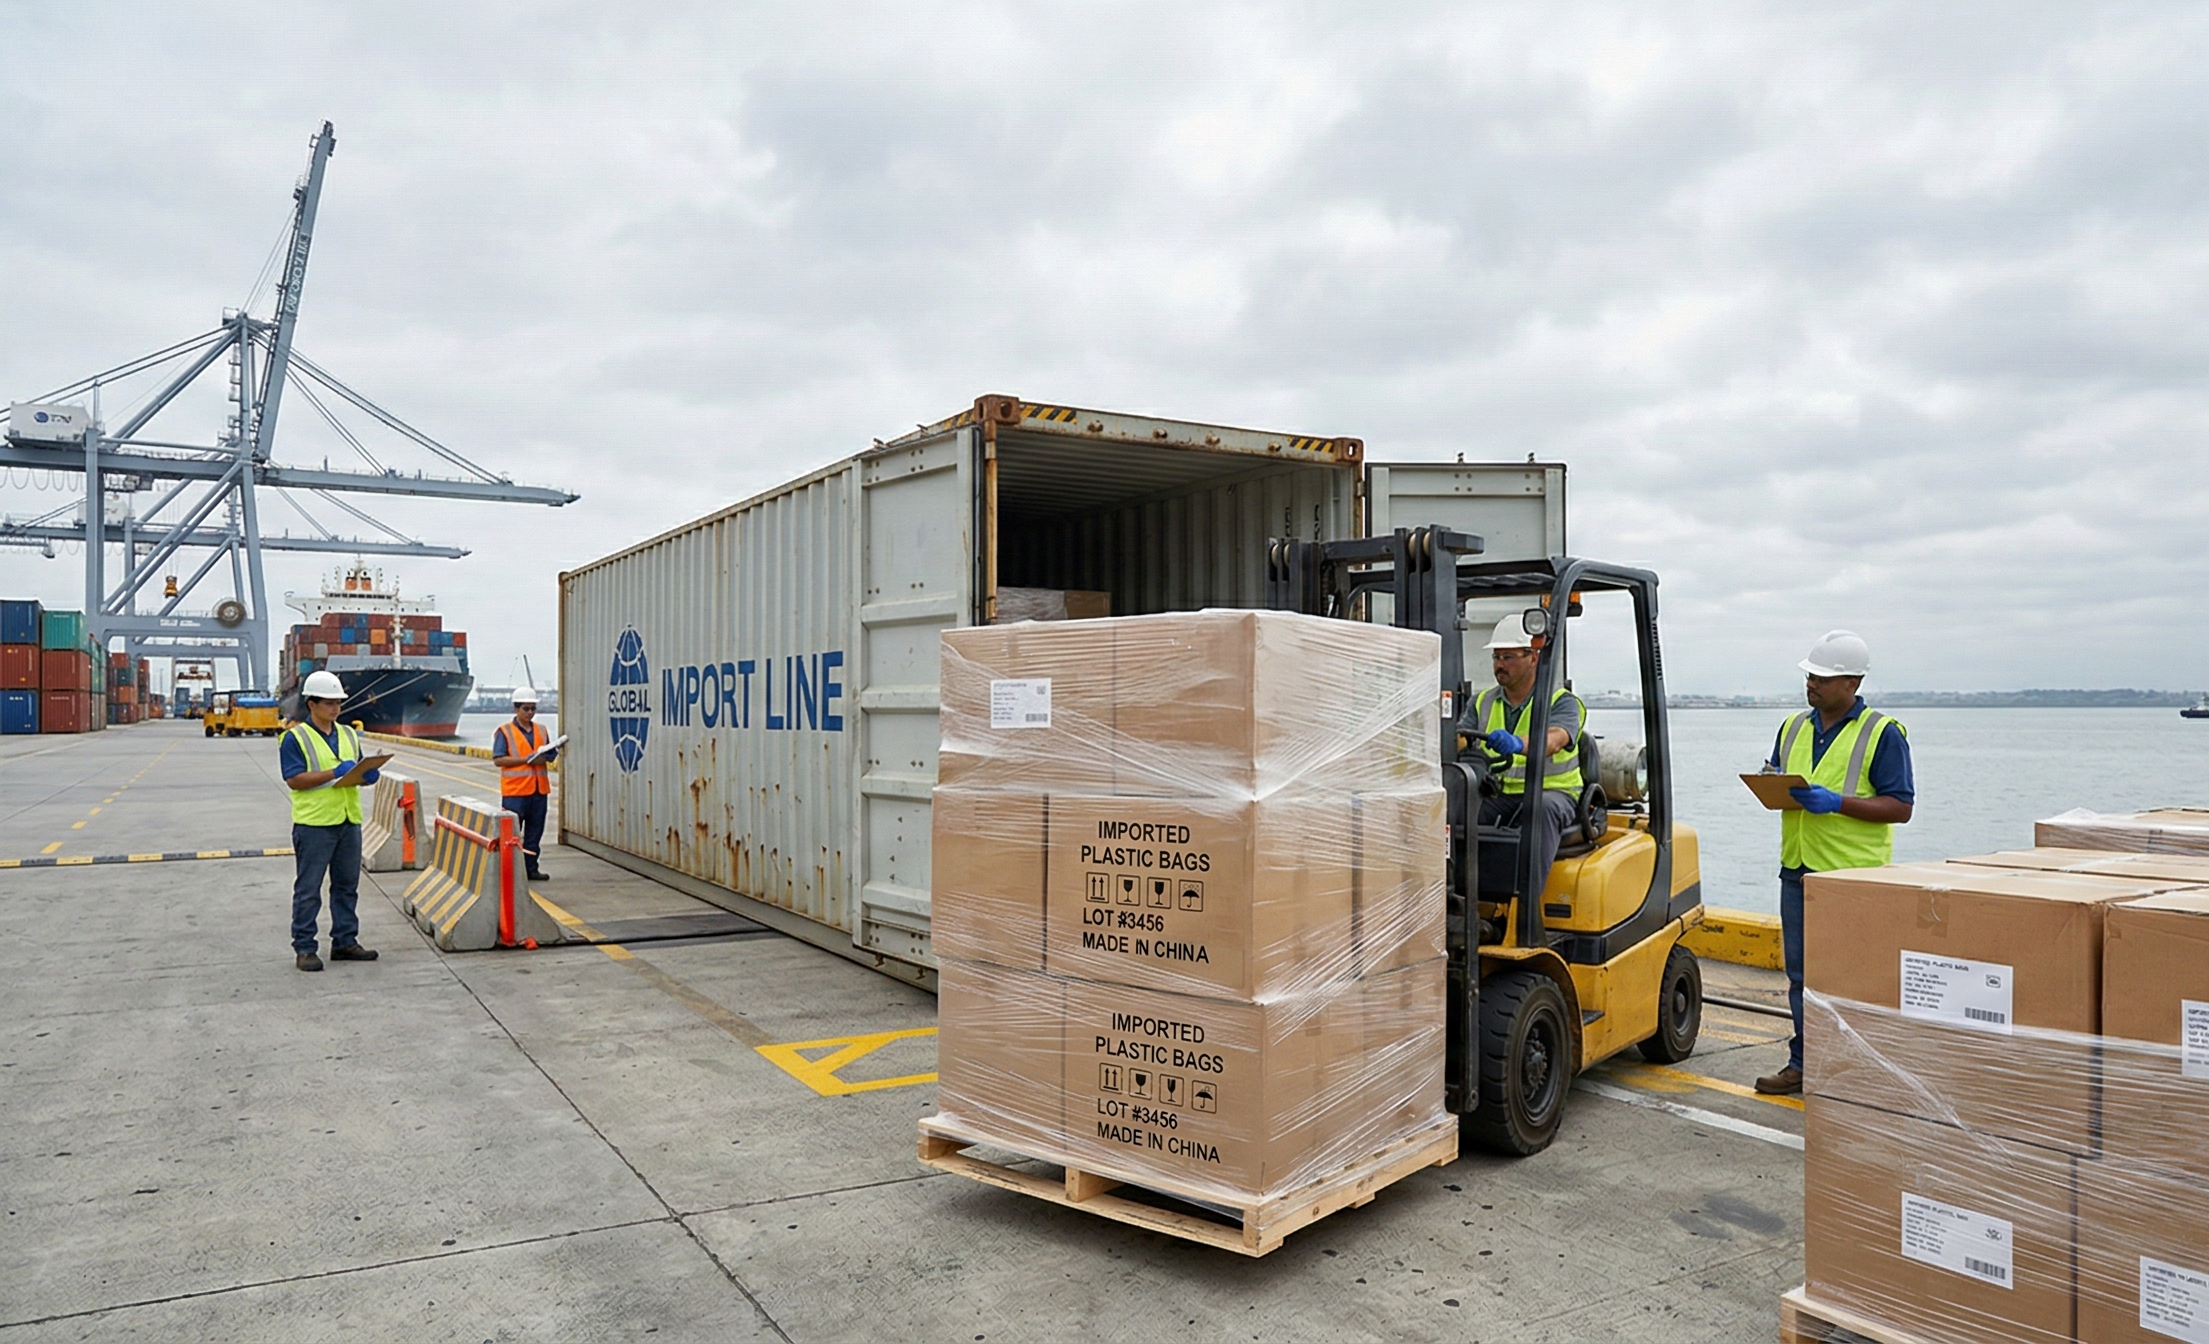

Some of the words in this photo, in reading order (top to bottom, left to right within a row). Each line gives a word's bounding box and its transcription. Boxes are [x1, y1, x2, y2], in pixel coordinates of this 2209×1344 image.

[662, 659, 756, 729] IMPORT
[766, 650, 844, 732] LINE
[1098, 820, 1191, 844] IMPORTED
[1081, 844, 1154, 868] PLASTIC
[1159, 850, 1211, 872] BAGS
[1083, 907, 1115, 927] LOT
[1082, 931, 1129, 954] MADE
[1135, 938, 1150, 956] IN
[1154, 940, 1210, 964] CHINA
[1112, 1012, 1205, 1044] IMPORTED
[1095, 1035, 1168, 1065] PLASTIC
[1173, 1048, 1224, 1074] BAGS
[1097, 1097, 1129, 1119] LOT
[1132, 1104, 1178, 1130] #3456
[1097, 1121, 1143, 1146] MADE
[1148, 1131, 1163, 1151] IN
[1167, 1136, 1221, 1164] CHINA
